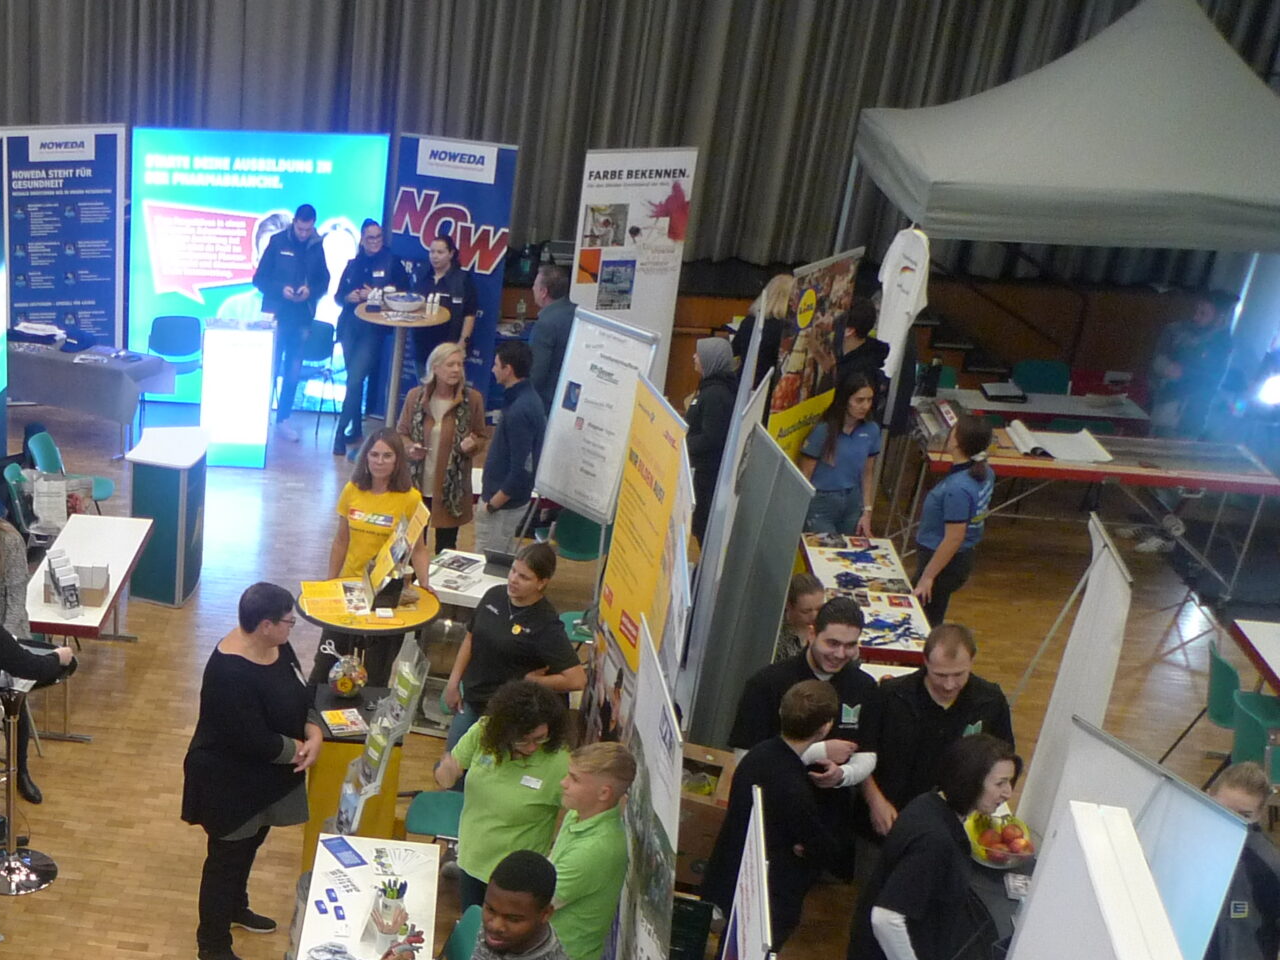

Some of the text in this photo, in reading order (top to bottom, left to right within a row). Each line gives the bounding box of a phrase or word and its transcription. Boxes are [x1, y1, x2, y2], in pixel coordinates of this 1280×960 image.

[39, 141, 85, 150] NOWEDA
[429, 150, 485, 166] NOWEDA
[12, 167, 92, 179] NOWEDA STEHT FÜR
[588, 168, 690, 180] FARBE BEKENNEN.
[12, 179, 64, 189] GESUNDHEIT
[392, 187, 509, 274] NOW
